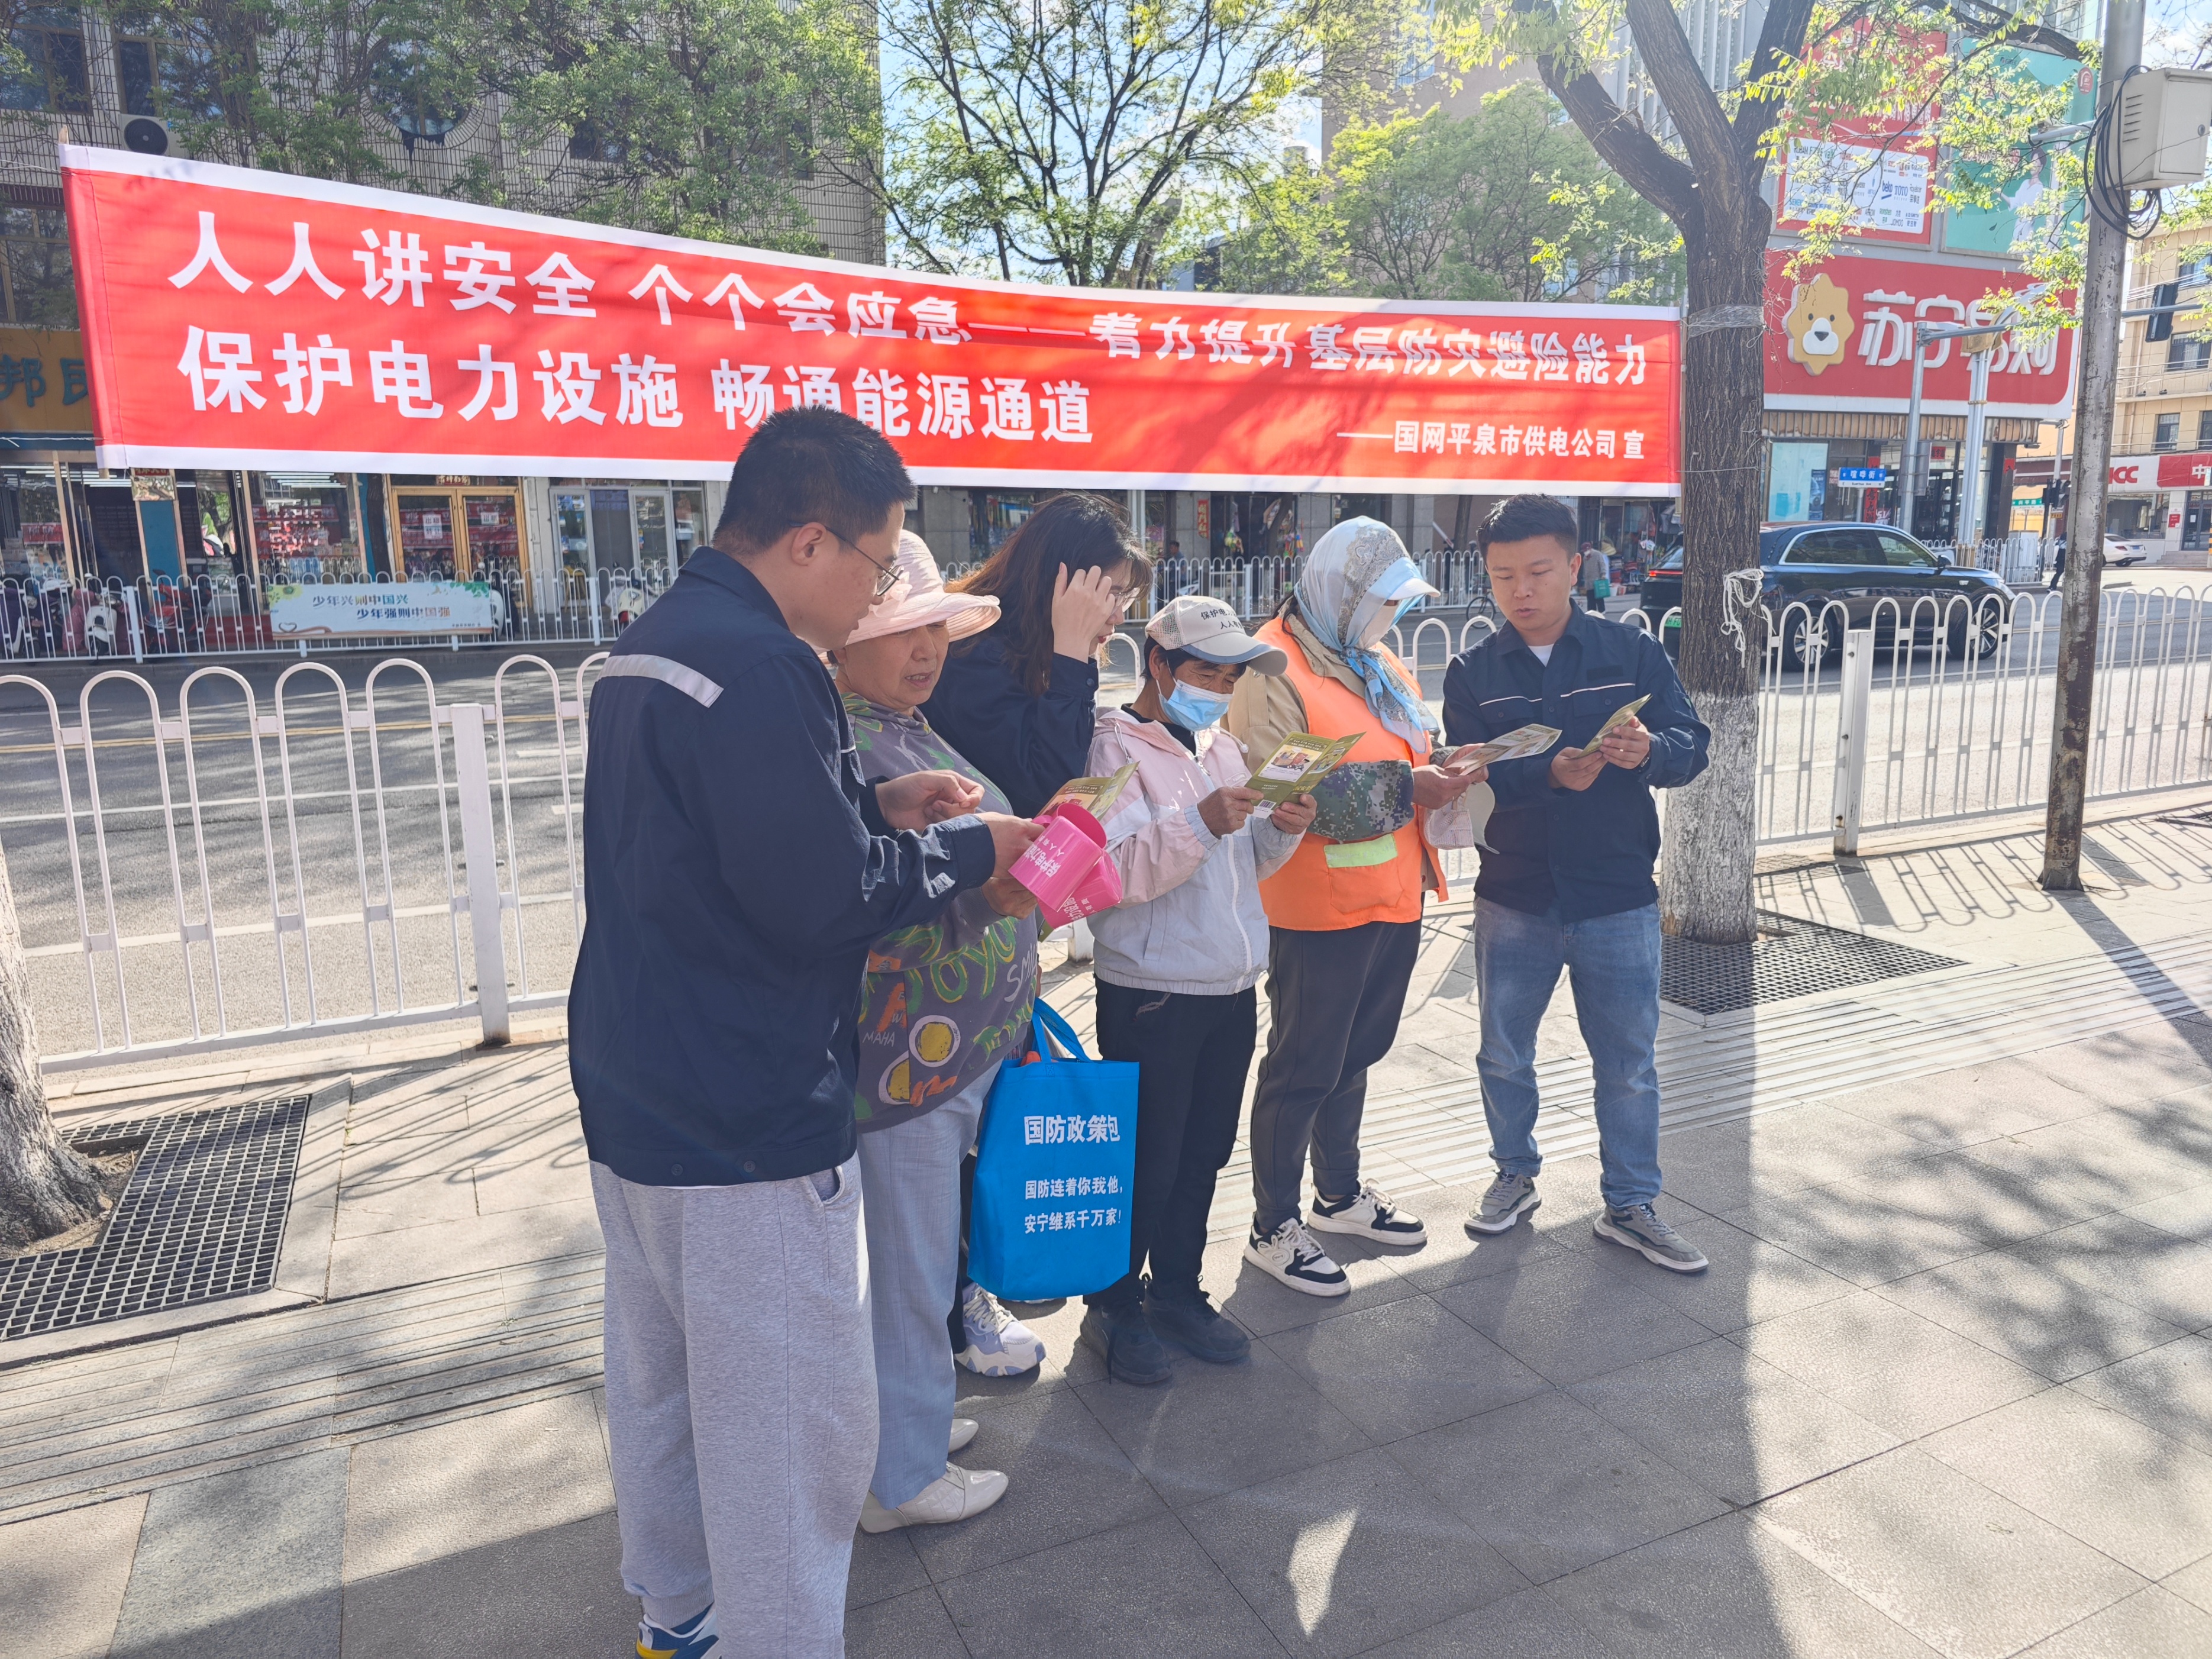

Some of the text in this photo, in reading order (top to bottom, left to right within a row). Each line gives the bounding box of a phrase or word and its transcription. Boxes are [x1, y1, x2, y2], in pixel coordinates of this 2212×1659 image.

[1894, 186, 1908, 196] TOTO
[167, 211, 597, 318] 人人讲安全
[177, 325, 1093, 443] 保护电力设施 畅通能源通道
[1623, 430, 1645, 460] 宣
[312, 595, 409, 607] 少年兴则中国兴
[357, 606, 451, 620] 少年强则中国强
[1024, 1115, 1120, 1145] 国防政策包
